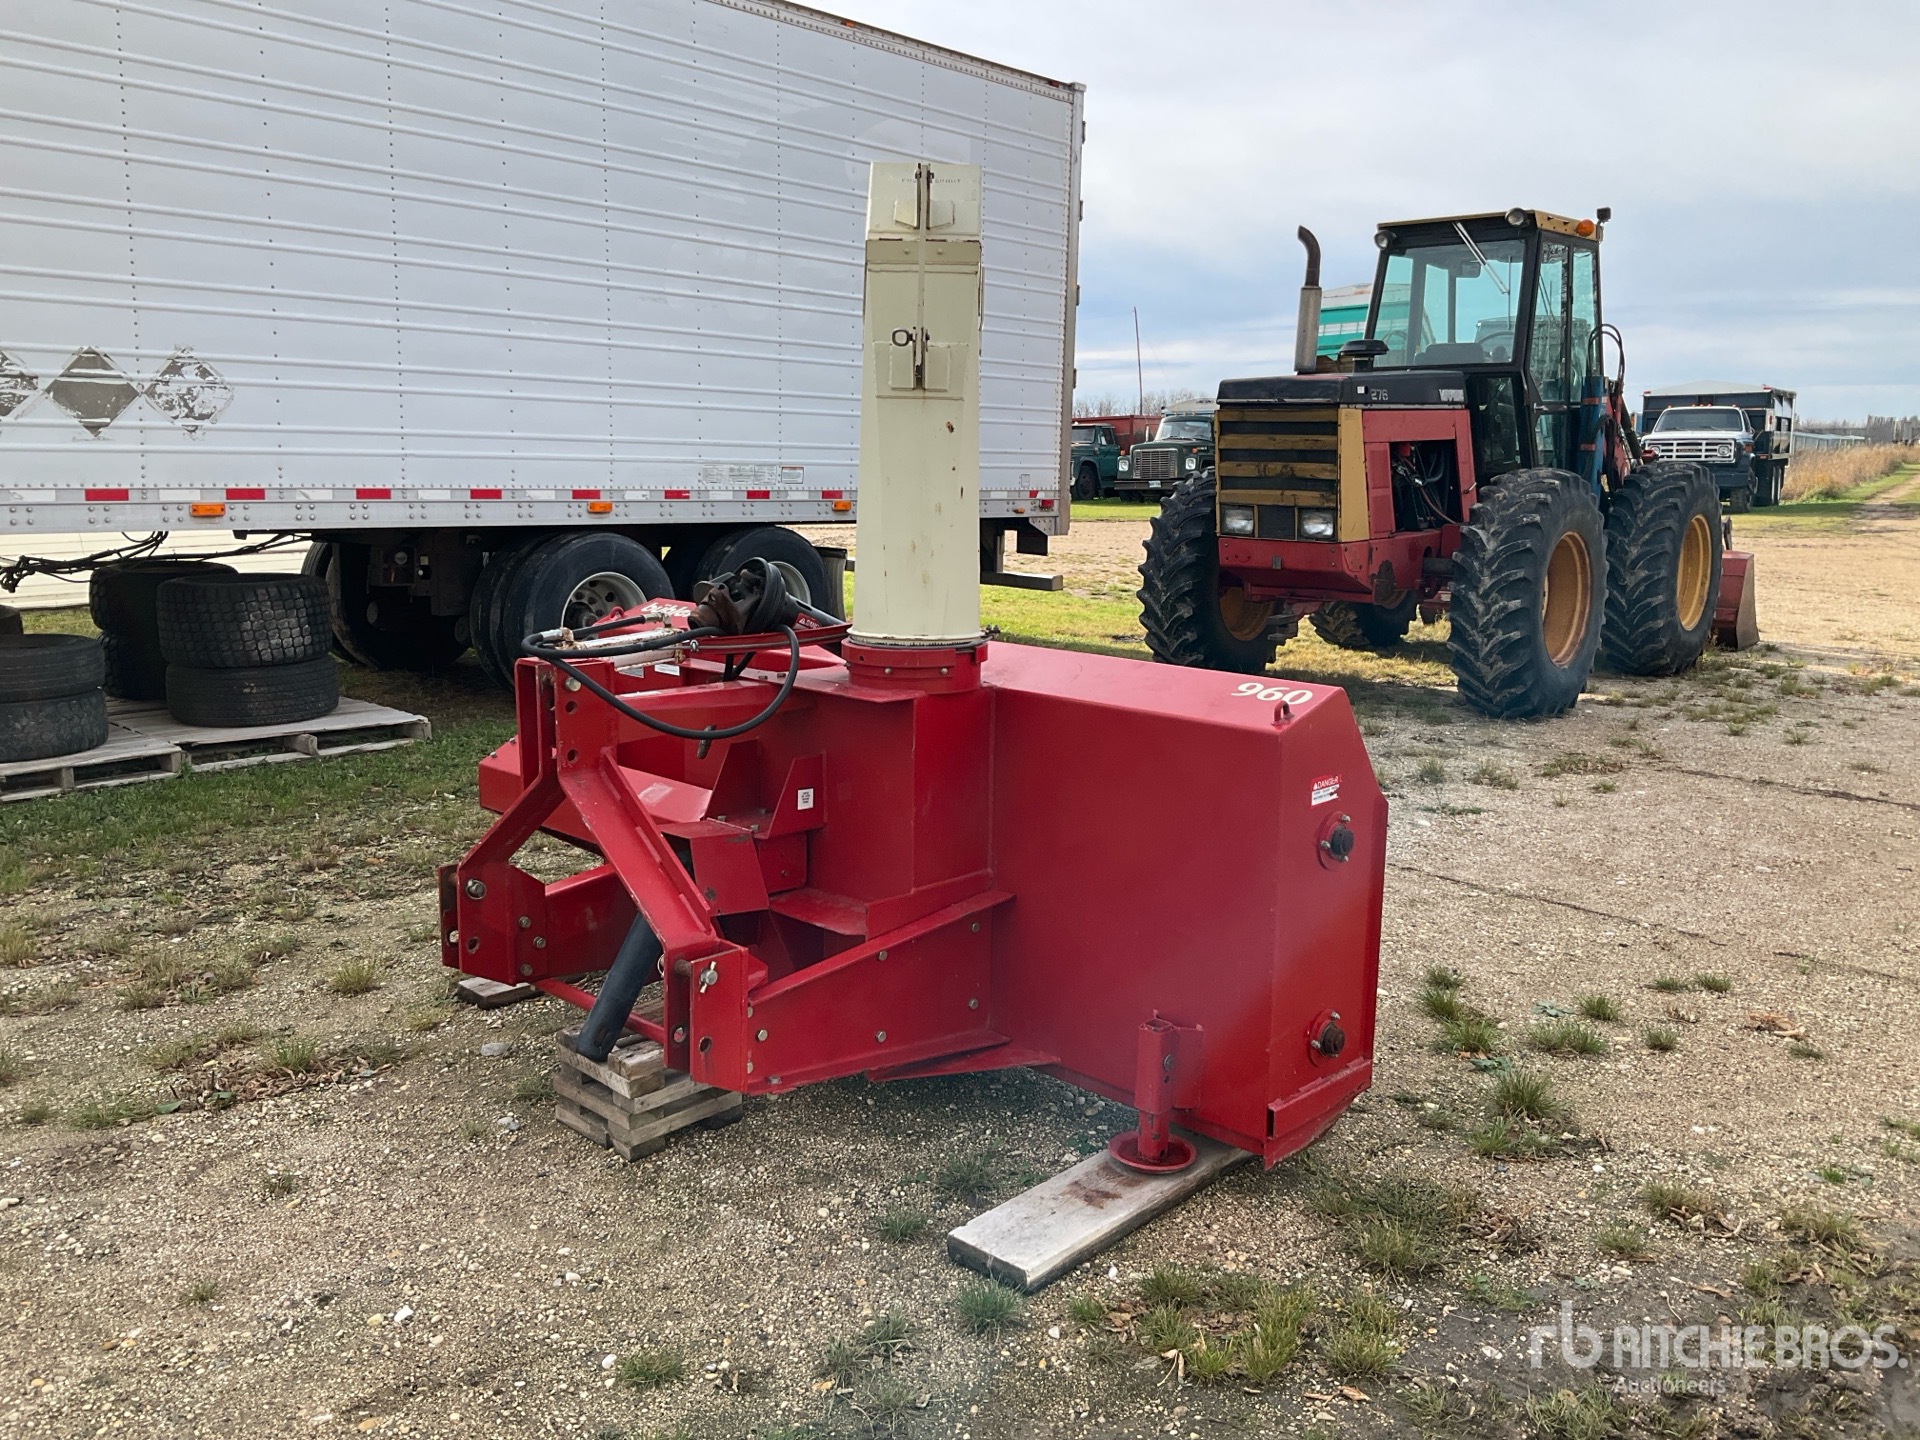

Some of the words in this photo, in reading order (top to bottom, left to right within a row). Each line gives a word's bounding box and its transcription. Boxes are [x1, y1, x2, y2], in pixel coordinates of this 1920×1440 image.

[1371, 388, 1389, 401] 276
[1231, 682, 1313, 705] 960
[1317, 775, 1339, 789] DANGER
